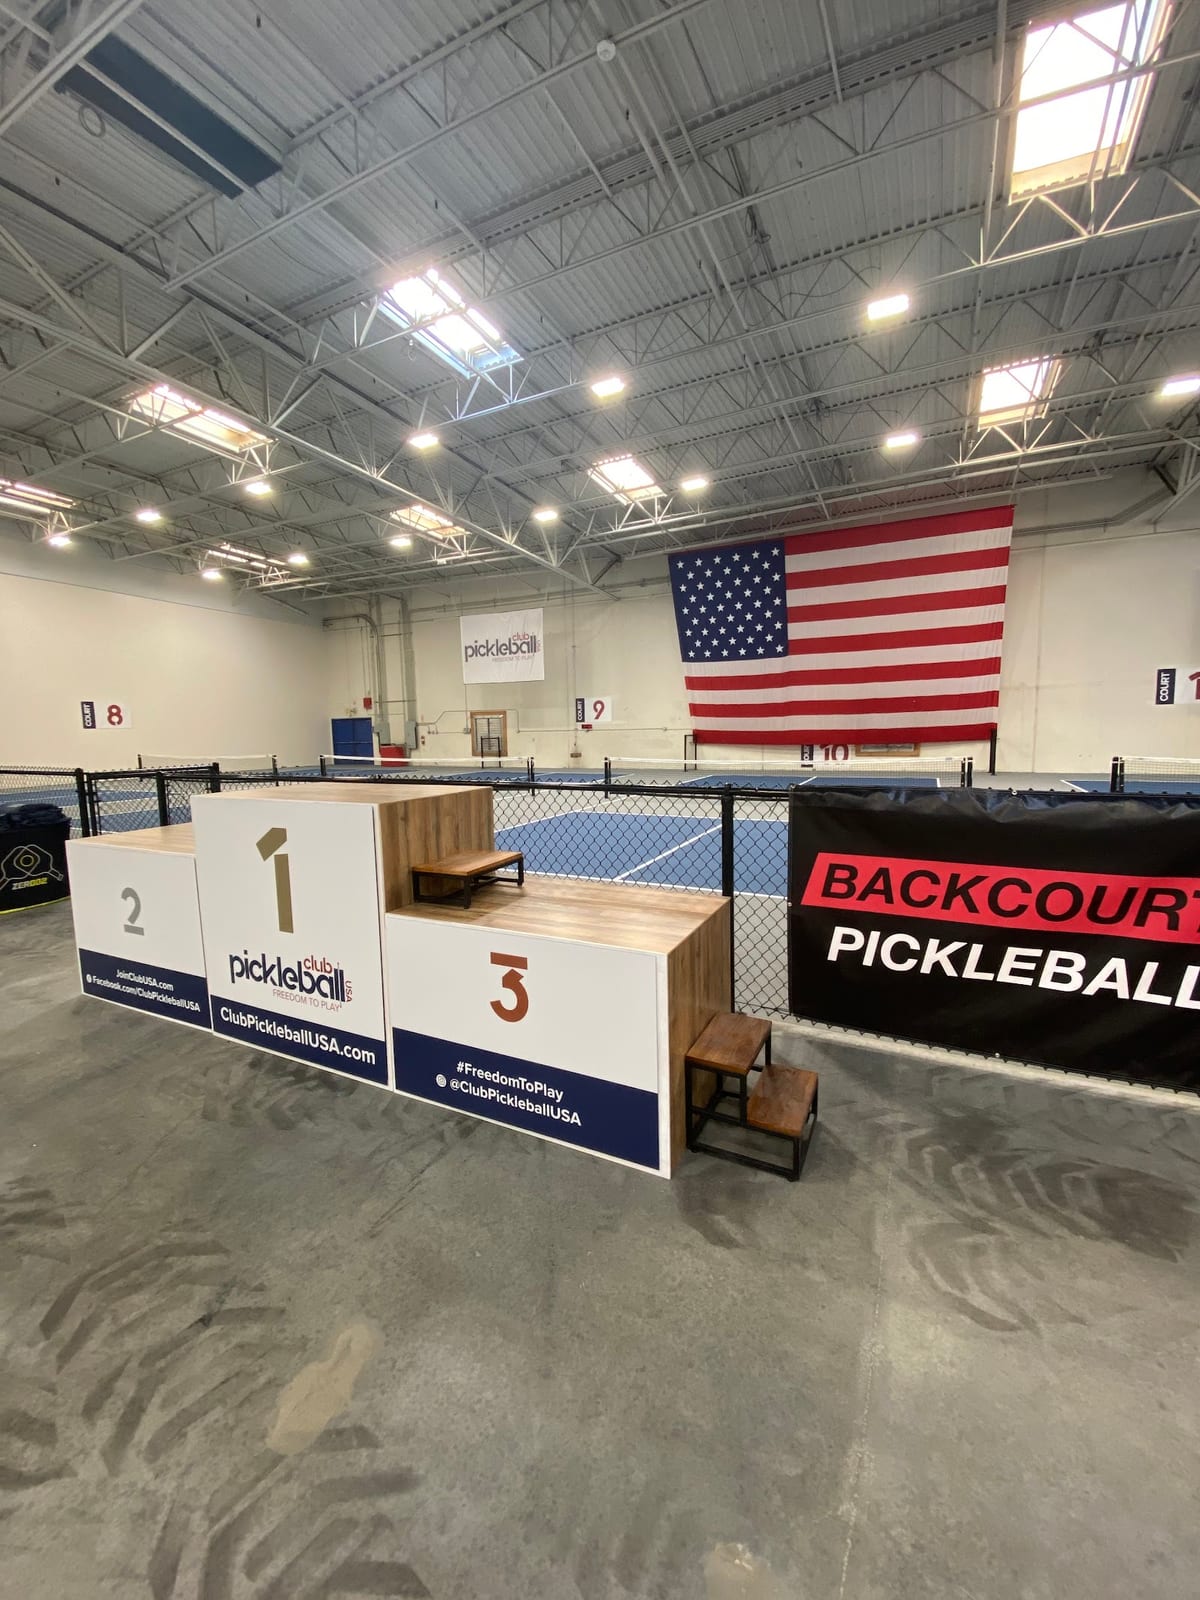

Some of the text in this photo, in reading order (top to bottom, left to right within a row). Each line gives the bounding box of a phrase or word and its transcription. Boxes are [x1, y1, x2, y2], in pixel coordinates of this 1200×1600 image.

[465, 635, 536, 662] pickleball
[512, 632, 529, 641] club
[1160, 672, 1170, 701] COURT
[84, 704, 92, 726] COURT
[107, 704, 123, 726] 8
[593, 700, 605, 720] 9
[820, 744, 849, 761] 10
[256, 827, 294, 933] 1
[121, 887, 144, 936] 2
[821, 863, 1200, 933] BACKCOUR
[229, 949, 346, 1002] pickleball
[303, 955, 333, 974] club
[827, 926, 1200, 1010] PICKLEBALL
[92, 974, 200, 1012] Facebook.com/ClubPickleballUSA
[116, 969, 174, 992] JoinClubUSA.com
[345, 980, 353, 1002] USA
[490, 952, 529, 1022] 3
[273, 988, 340, 1012] FREEDOM TO PLAY
[220, 1006, 376, 1065] ClubPickleballUSA.com
[456, 1061, 564, 1103] #FreedomToPlay
[450, 1078, 582, 1127] @ClubPickleballUSA
